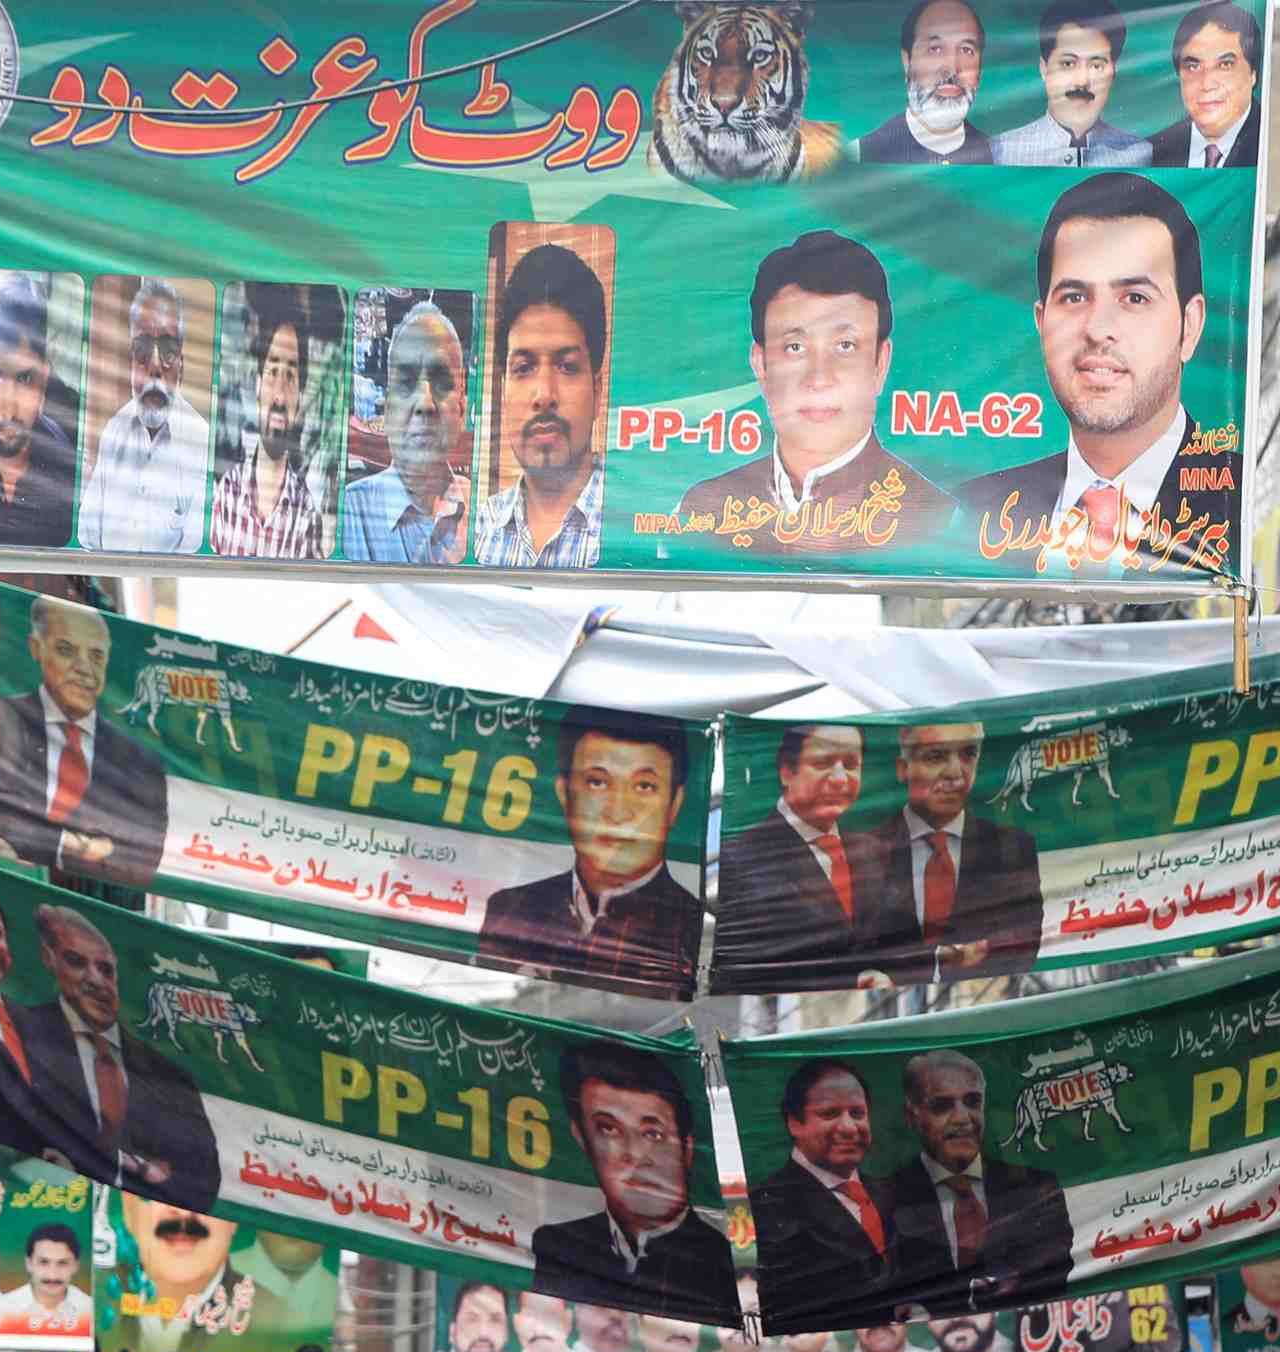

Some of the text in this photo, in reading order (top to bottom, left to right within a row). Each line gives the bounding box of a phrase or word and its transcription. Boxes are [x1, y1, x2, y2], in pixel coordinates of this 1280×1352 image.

[29, 0, 643, 184] ووٹ کو عزت دو
[618, 407, 762, 454] PP-16
[891, 391, 1045, 437] NA-62
[1180, 467, 1235, 491] MNA
[634, 512, 683, 535] MPA
[716, 468, 907, 548] شیخ ارسلان حفیظ
[166, 671, 219, 701] VOTE
[1041, 733, 1101, 770] VOTE
[296, 723, 539, 832] PP-16
[182, 833, 469, 917] شیخ ارسلان حفیظ
[1059, 895, 1154, 940] حفیظ
[1152, 872, 1269, 930] ارسلان
[176, 990, 232, 1022] VOTE
[1021, 1030, 1095, 1079] شیر
[321, 1050, 552, 1171] PP-16
[1045, 1071, 1100, 1107] VOTE
[239, 1151, 518, 1248] شیخ ارسلان حفیظ
[1089, 1217, 1180, 1265] حفیظ
[1129, 1305, 1169, 1345] 62
